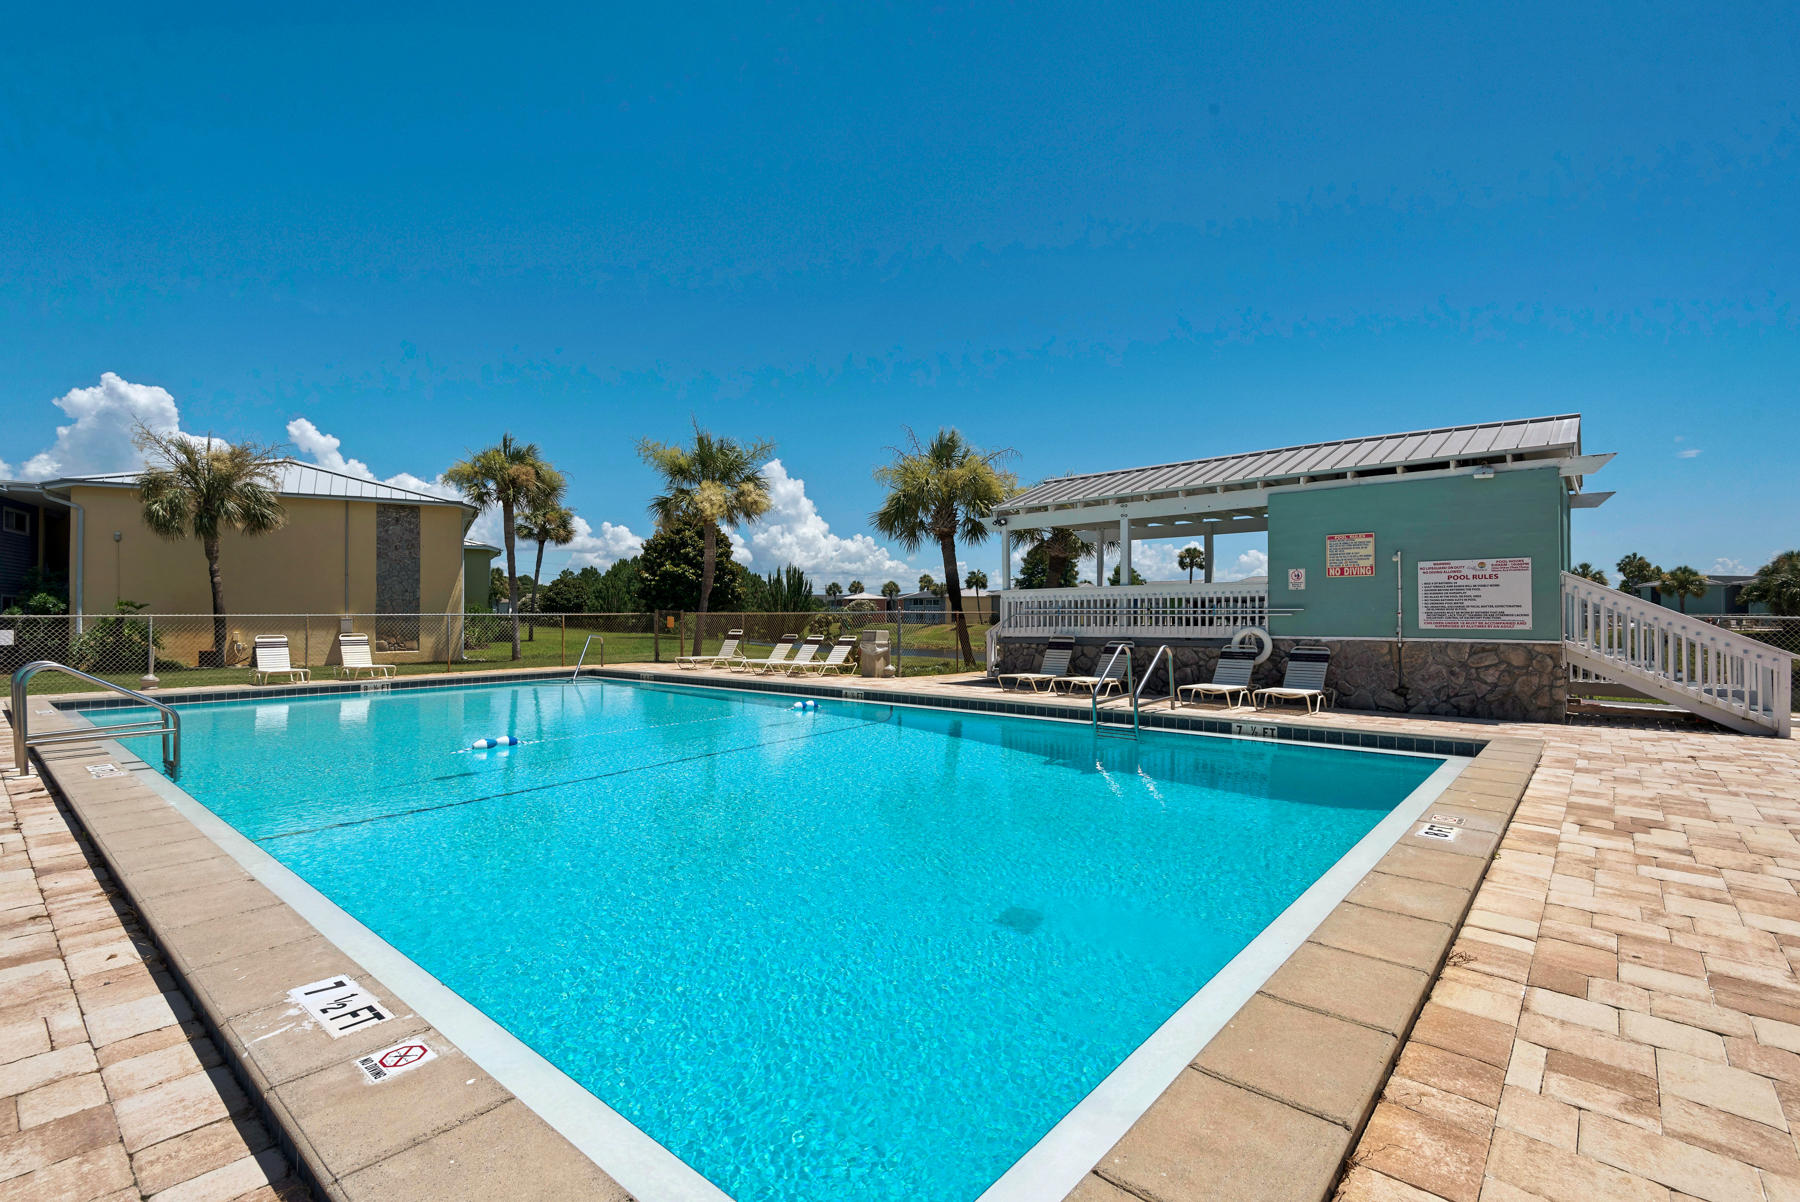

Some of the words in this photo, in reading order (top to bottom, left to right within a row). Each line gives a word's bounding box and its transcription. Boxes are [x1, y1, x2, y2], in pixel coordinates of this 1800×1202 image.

[1329, 568, 1341, 576] NO
[1344, 566, 1372, 576] DIVING
[1236, 725, 1243, 735] 7
[1262, 728, 1276, 739] FT
[1428, 824, 1454, 833] FT
[329, 1005, 386, 1031] FT
[359, 1057, 375, 1068] NO
[364, 1062, 387, 1080] DIVING
